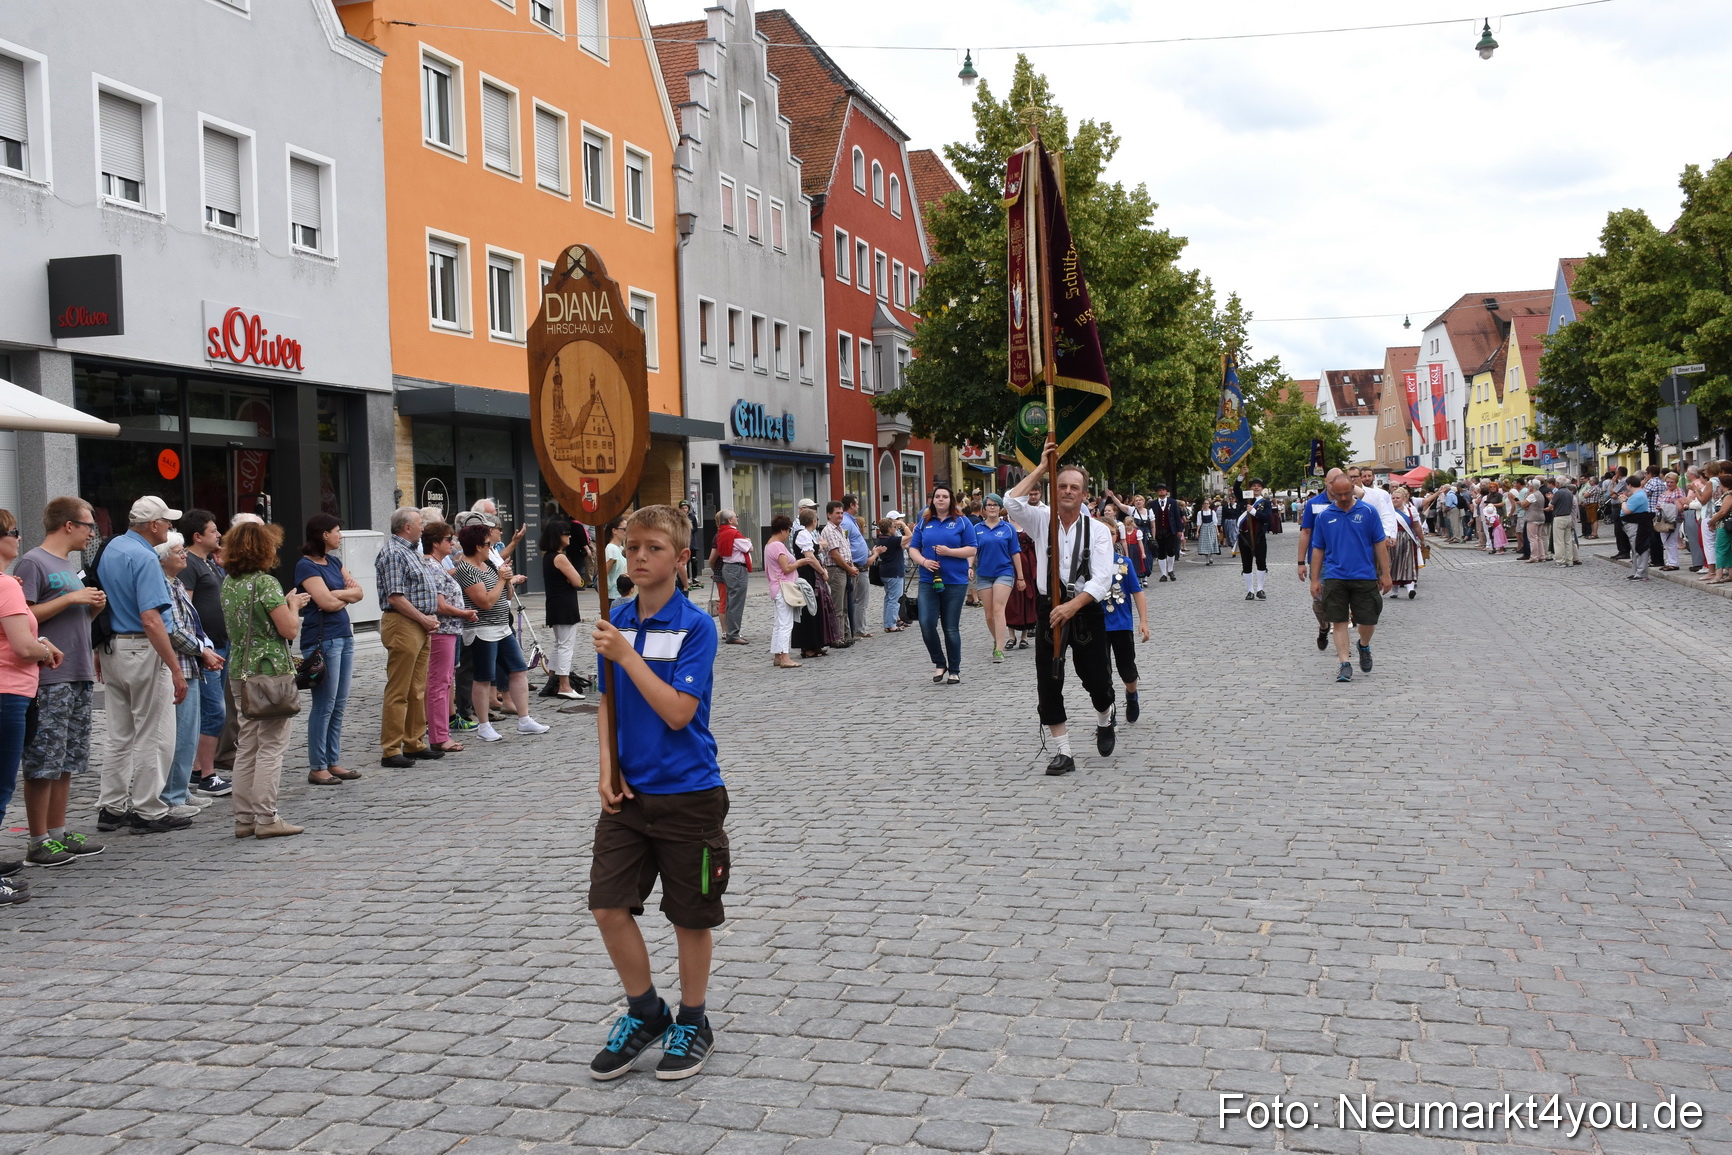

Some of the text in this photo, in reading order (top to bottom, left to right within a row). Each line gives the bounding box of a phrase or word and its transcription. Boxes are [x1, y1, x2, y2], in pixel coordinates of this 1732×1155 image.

[58, 305, 109, 328] s.Oliver
[545, 291, 613, 322] DIANA
[207, 306, 305, 371] s.Oliver
[546, 323, 614, 335] HIRSCHAU e.V.
[733, 399, 783, 440] Eilles
[162, 456, 177, 469] SALE
[427, 490, 444, 501] Dianas
